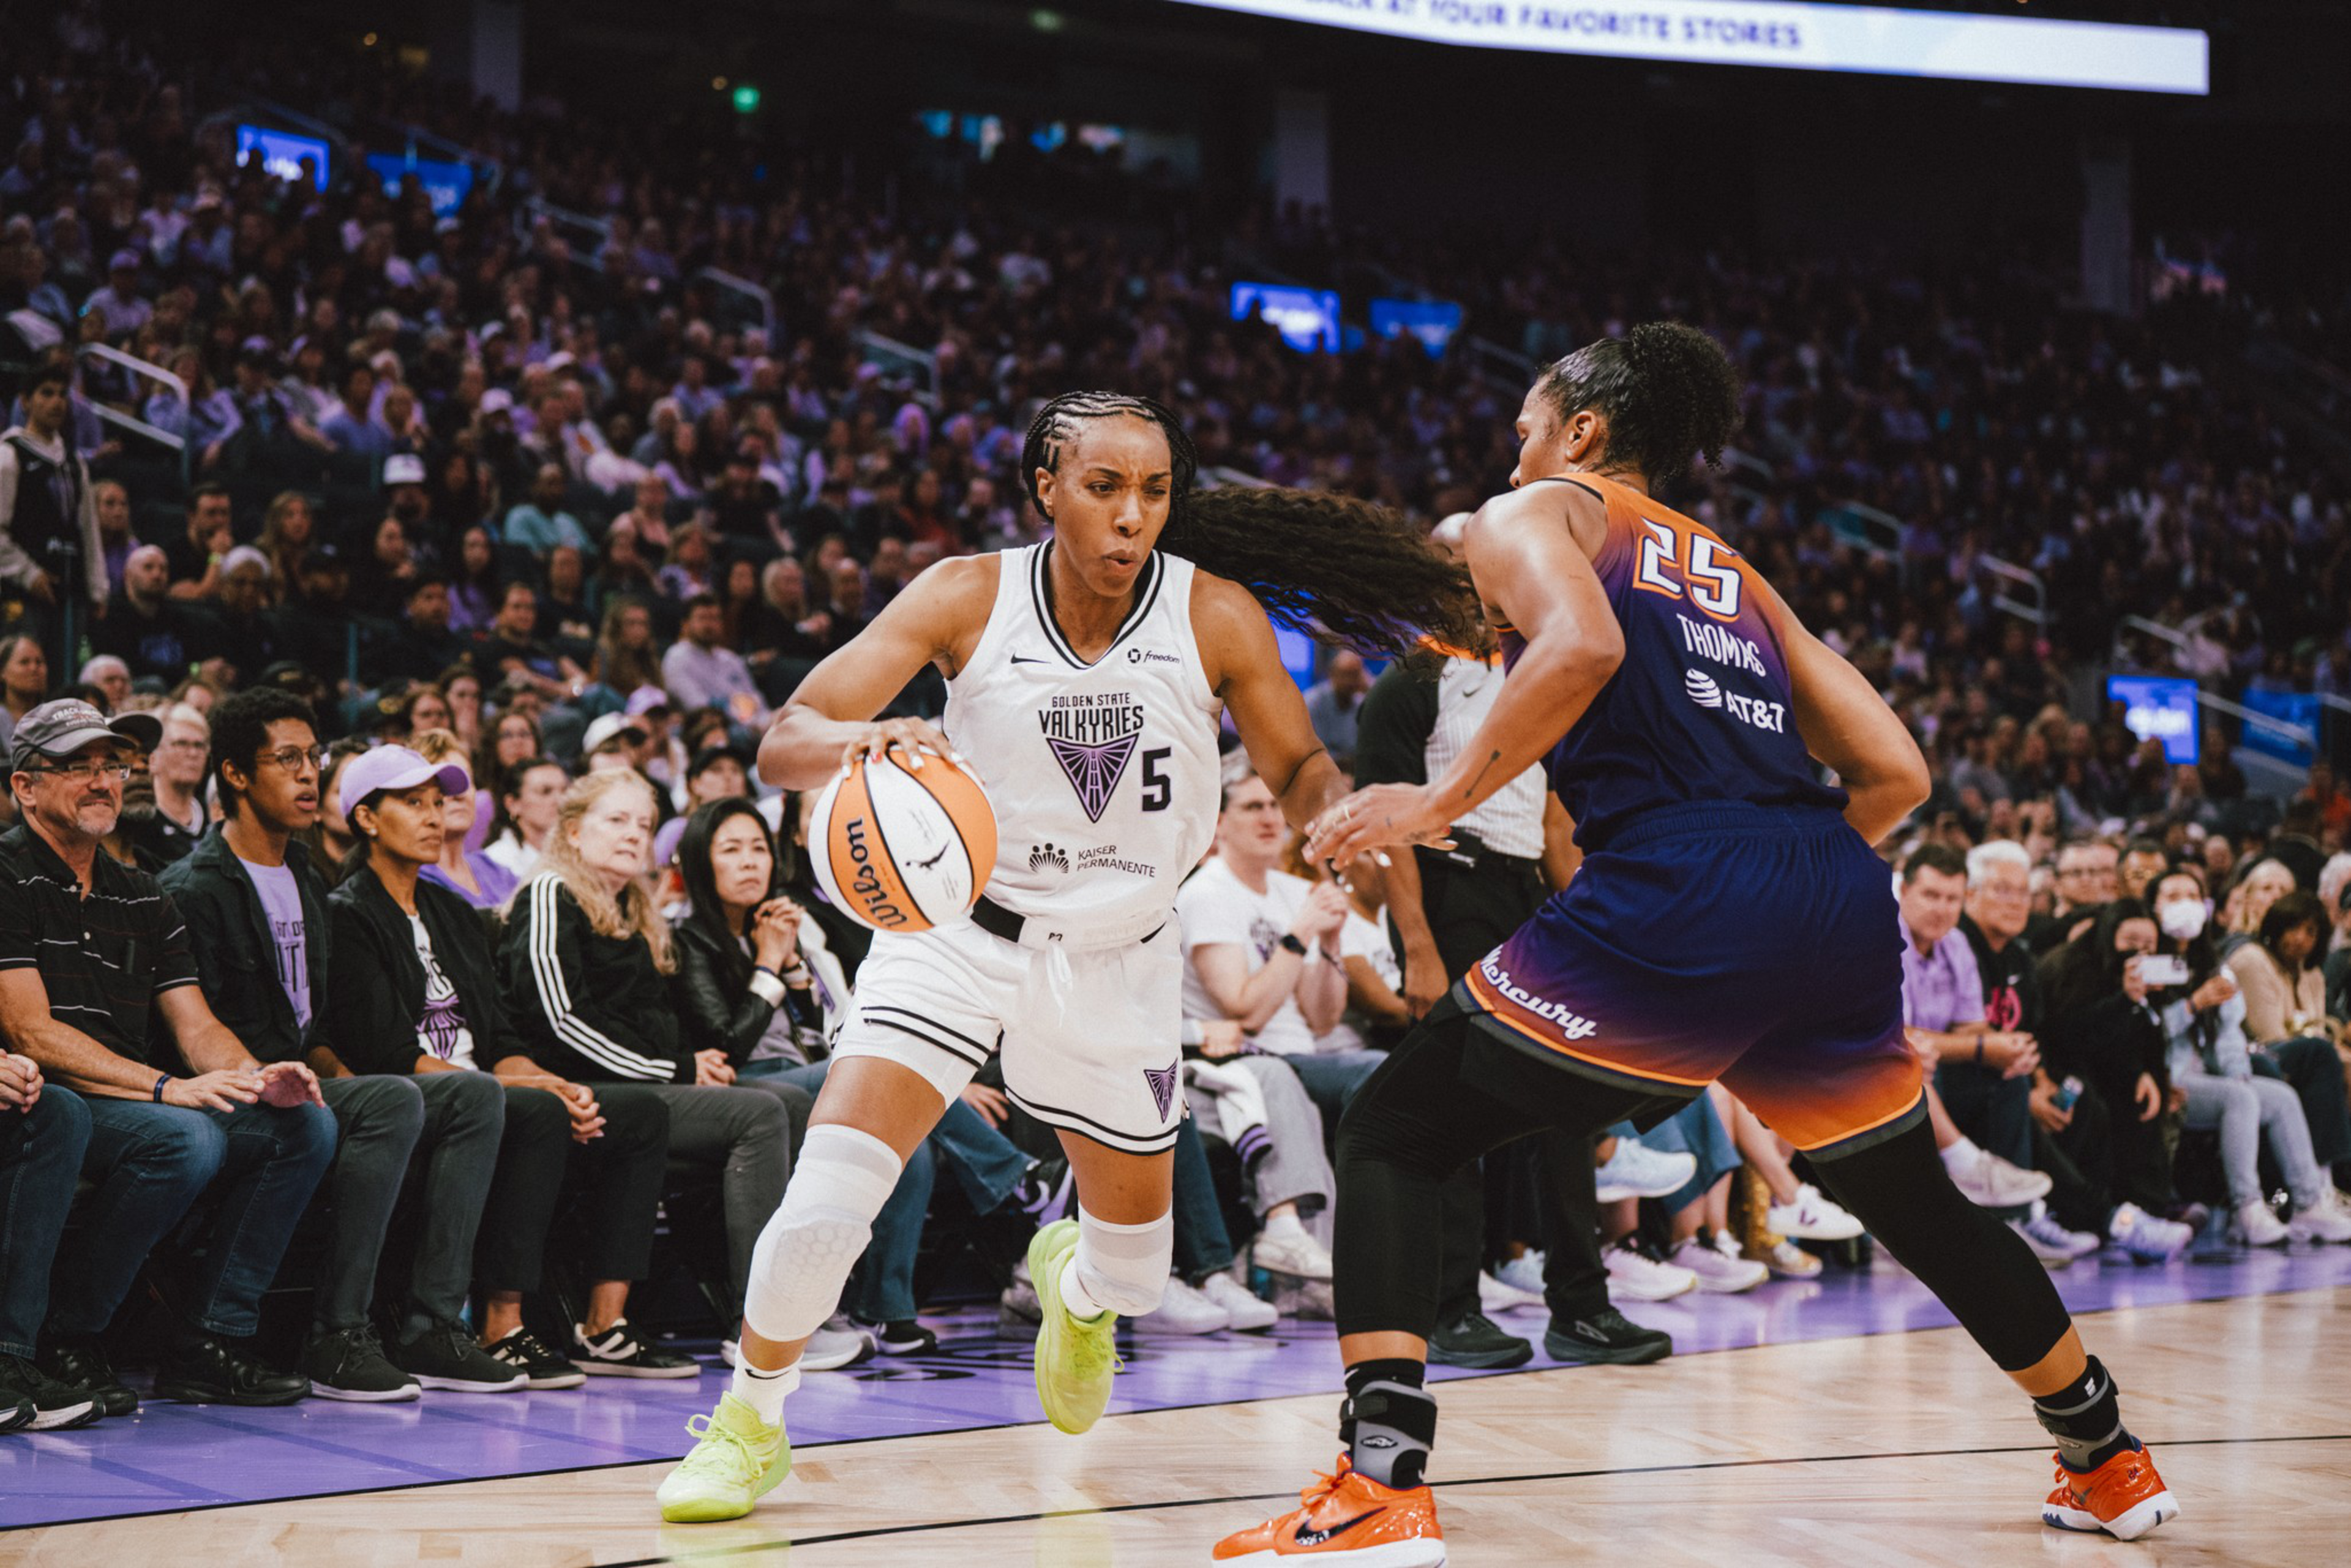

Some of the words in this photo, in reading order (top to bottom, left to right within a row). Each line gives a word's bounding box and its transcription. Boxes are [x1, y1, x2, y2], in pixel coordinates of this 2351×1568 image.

[1518, 4, 1669, 40] FAVORITE
[1682, 17, 1802, 48] STORES
[1633, 516, 1742, 622] 25
[1143, 650, 1180, 664] freedom
[1676, 613, 1766, 677] THOMAS
[1052, 695, 1093, 707] GOLDEN
[1098, 692, 1131, 705] STATE
[1725, 689, 1785, 733] AT&T
[1039, 705, 1144, 743] VALKYRIES
[1141, 747, 1172, 812] 5
[846, 817, 907, 927] Wilson
[1077, 858, 1156, 877] PERMANENTE
[1078, 845, 1117, 860] KAISER
